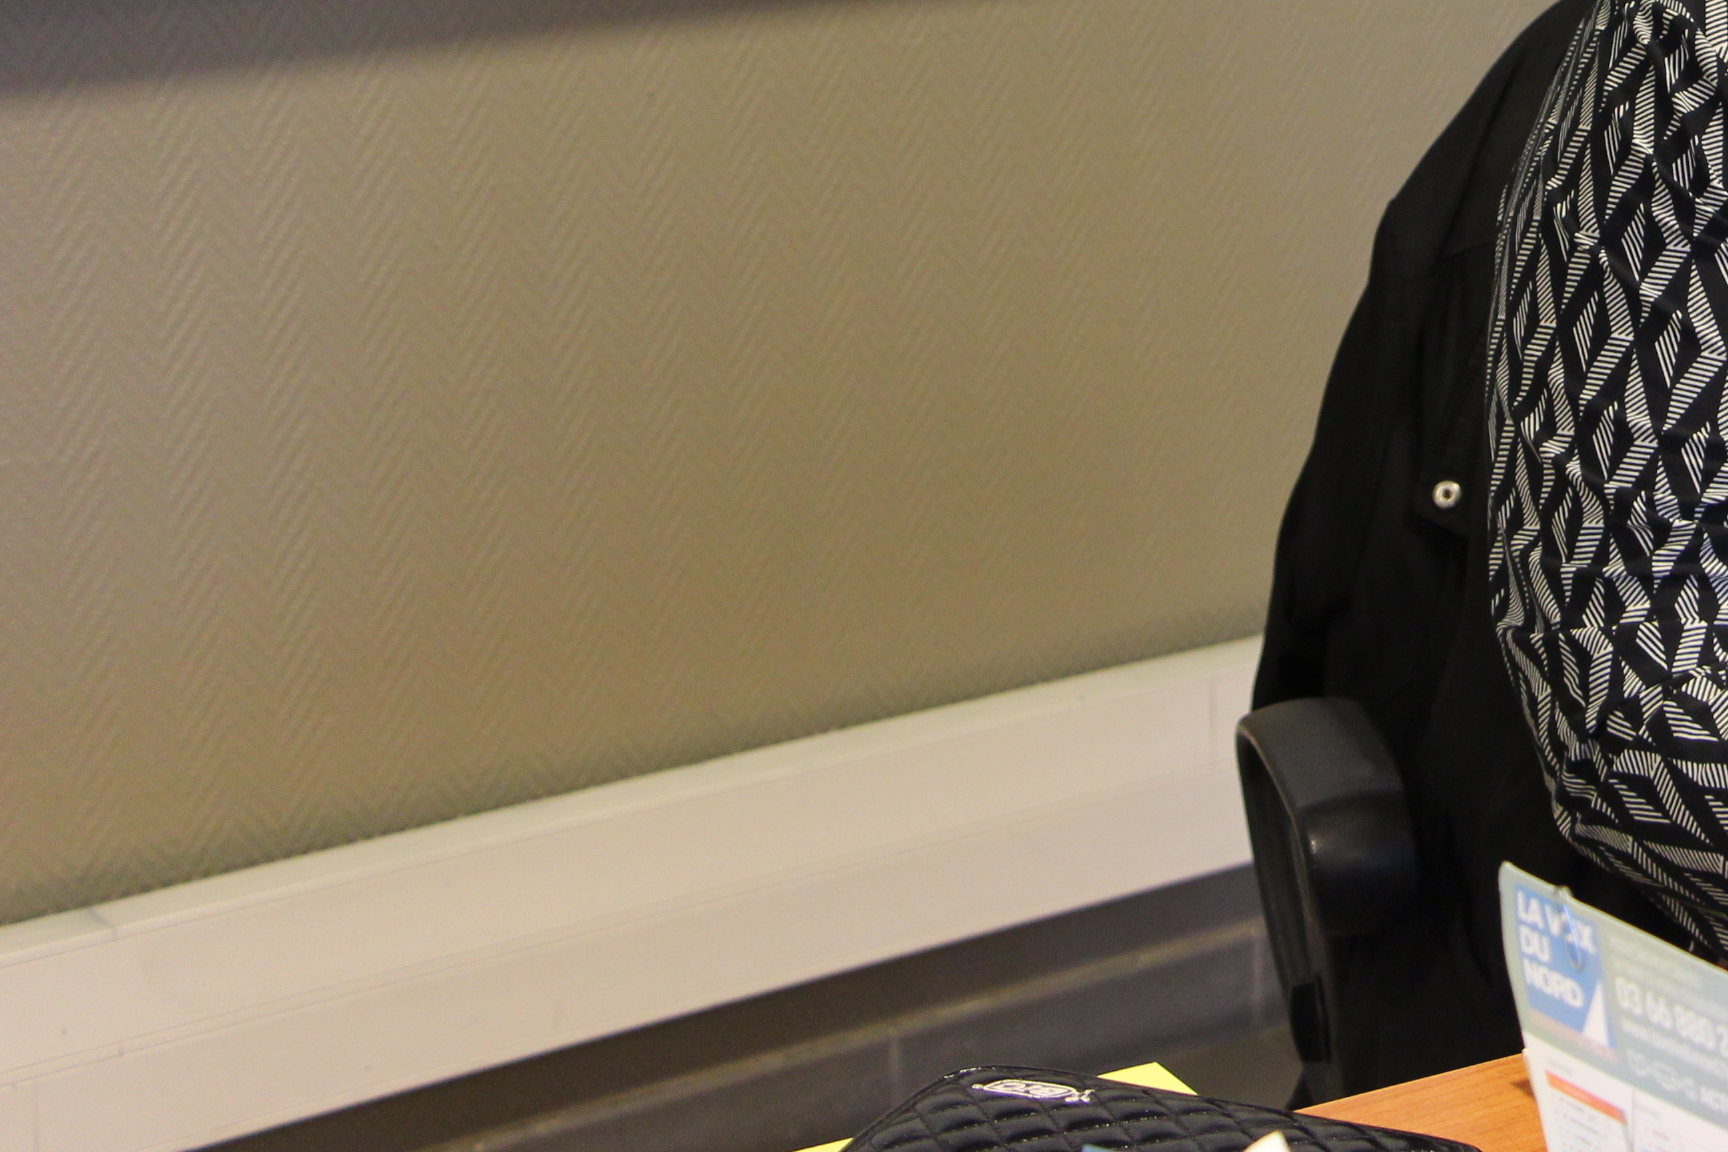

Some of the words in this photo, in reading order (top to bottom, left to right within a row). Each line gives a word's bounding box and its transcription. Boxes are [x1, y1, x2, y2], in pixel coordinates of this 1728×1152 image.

[1517, 890, 1545, 930] LA
[1519, 924, 1551, 962] DU
[1522, 958, 1585, 1008] NORD
